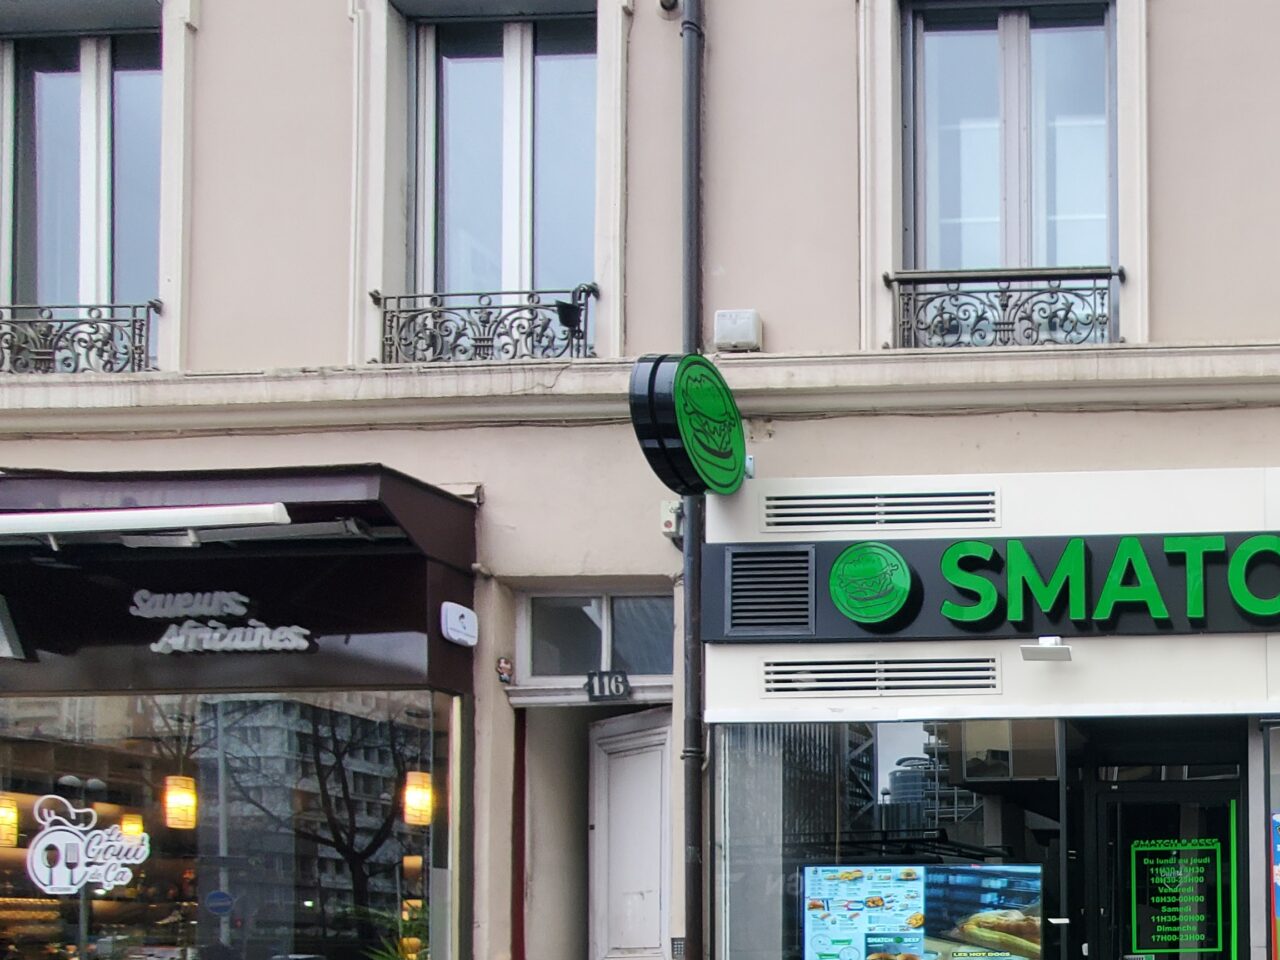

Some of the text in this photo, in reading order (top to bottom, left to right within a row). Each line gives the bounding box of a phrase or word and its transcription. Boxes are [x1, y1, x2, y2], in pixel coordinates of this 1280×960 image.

[129, 589, 250, 618] Saveurs
[150, 619, 311, 654] Africaines
[591, 674, 625, 696] 116
[1133, 839, 1178, 848] SMATCH
[1191, 838, 1219, 847] BEEF
[1190, 857, 1210, 865] jeudi
[1151, 915, 1205, 923] 11H30-00H00
[1151, 934, 1205, 942] 17H00-23H00
